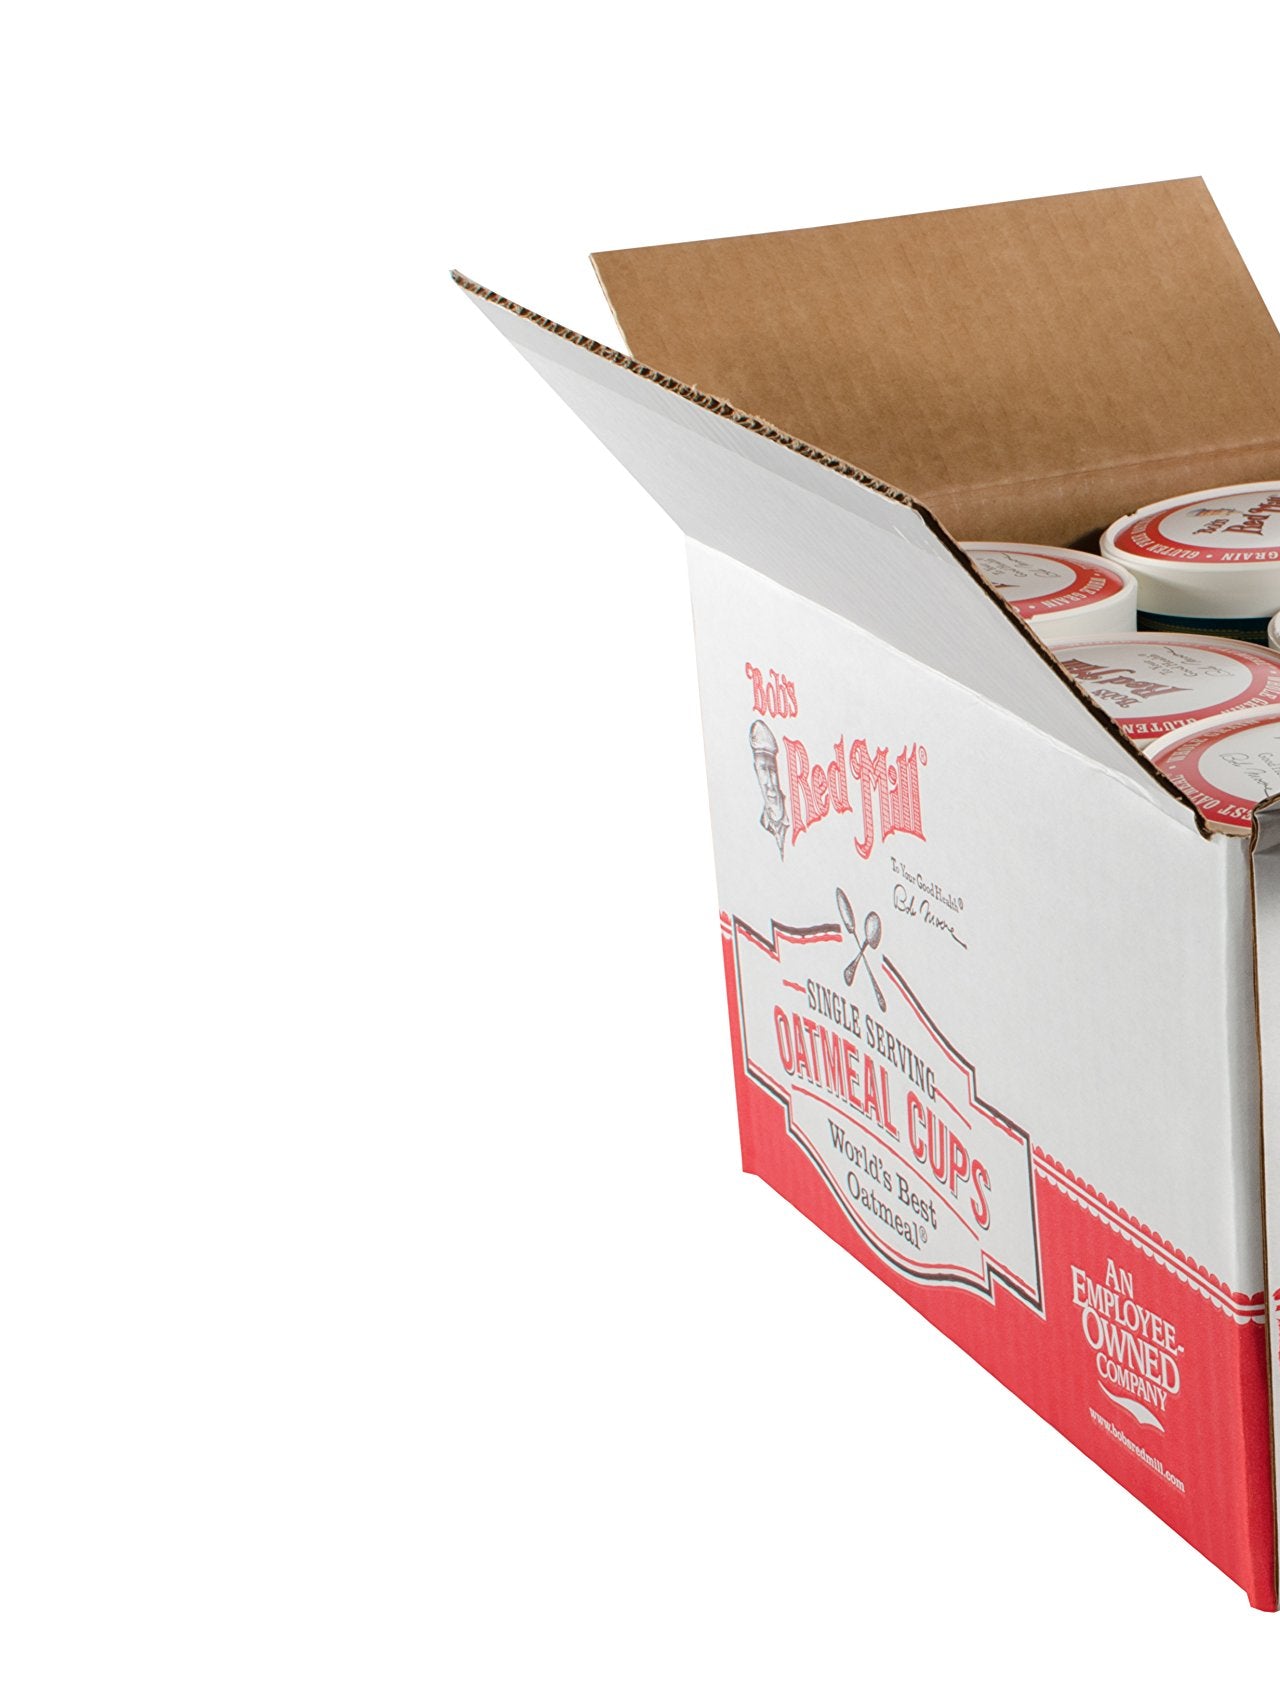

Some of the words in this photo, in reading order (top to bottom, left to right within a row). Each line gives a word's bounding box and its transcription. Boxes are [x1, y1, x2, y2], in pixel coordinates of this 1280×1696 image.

[1146, 543, 1200, 560] GLUTEN
[1221, 550, 1279, 561] GRAIN
[1041, 592, 1087, 609] GRAIN
[745, 661, 799, 719] Bob's
[783, 734, 853, 846] Red
[806, 977, 861, 1039] SINGLE
[866, 1014, 936, 1101] SERVING
[774, 1005, 900, 1142] OATMEAL
[907, 1090, 992, 1231] CUPS
[828, 1118, 892, 1193] World's
[896, 1172, 938, 1230] Best
[1070, 1264, 1185, 1356] EMPLOYEE-
[1105, 1257, 1134, 1299] AN
[1082, 1307, 1181, 1394] OWNED
[1096, 1351, 1168, 1412] COMPANY
[1088, 1407, 1186, 1493] www.bobsredmill.com
